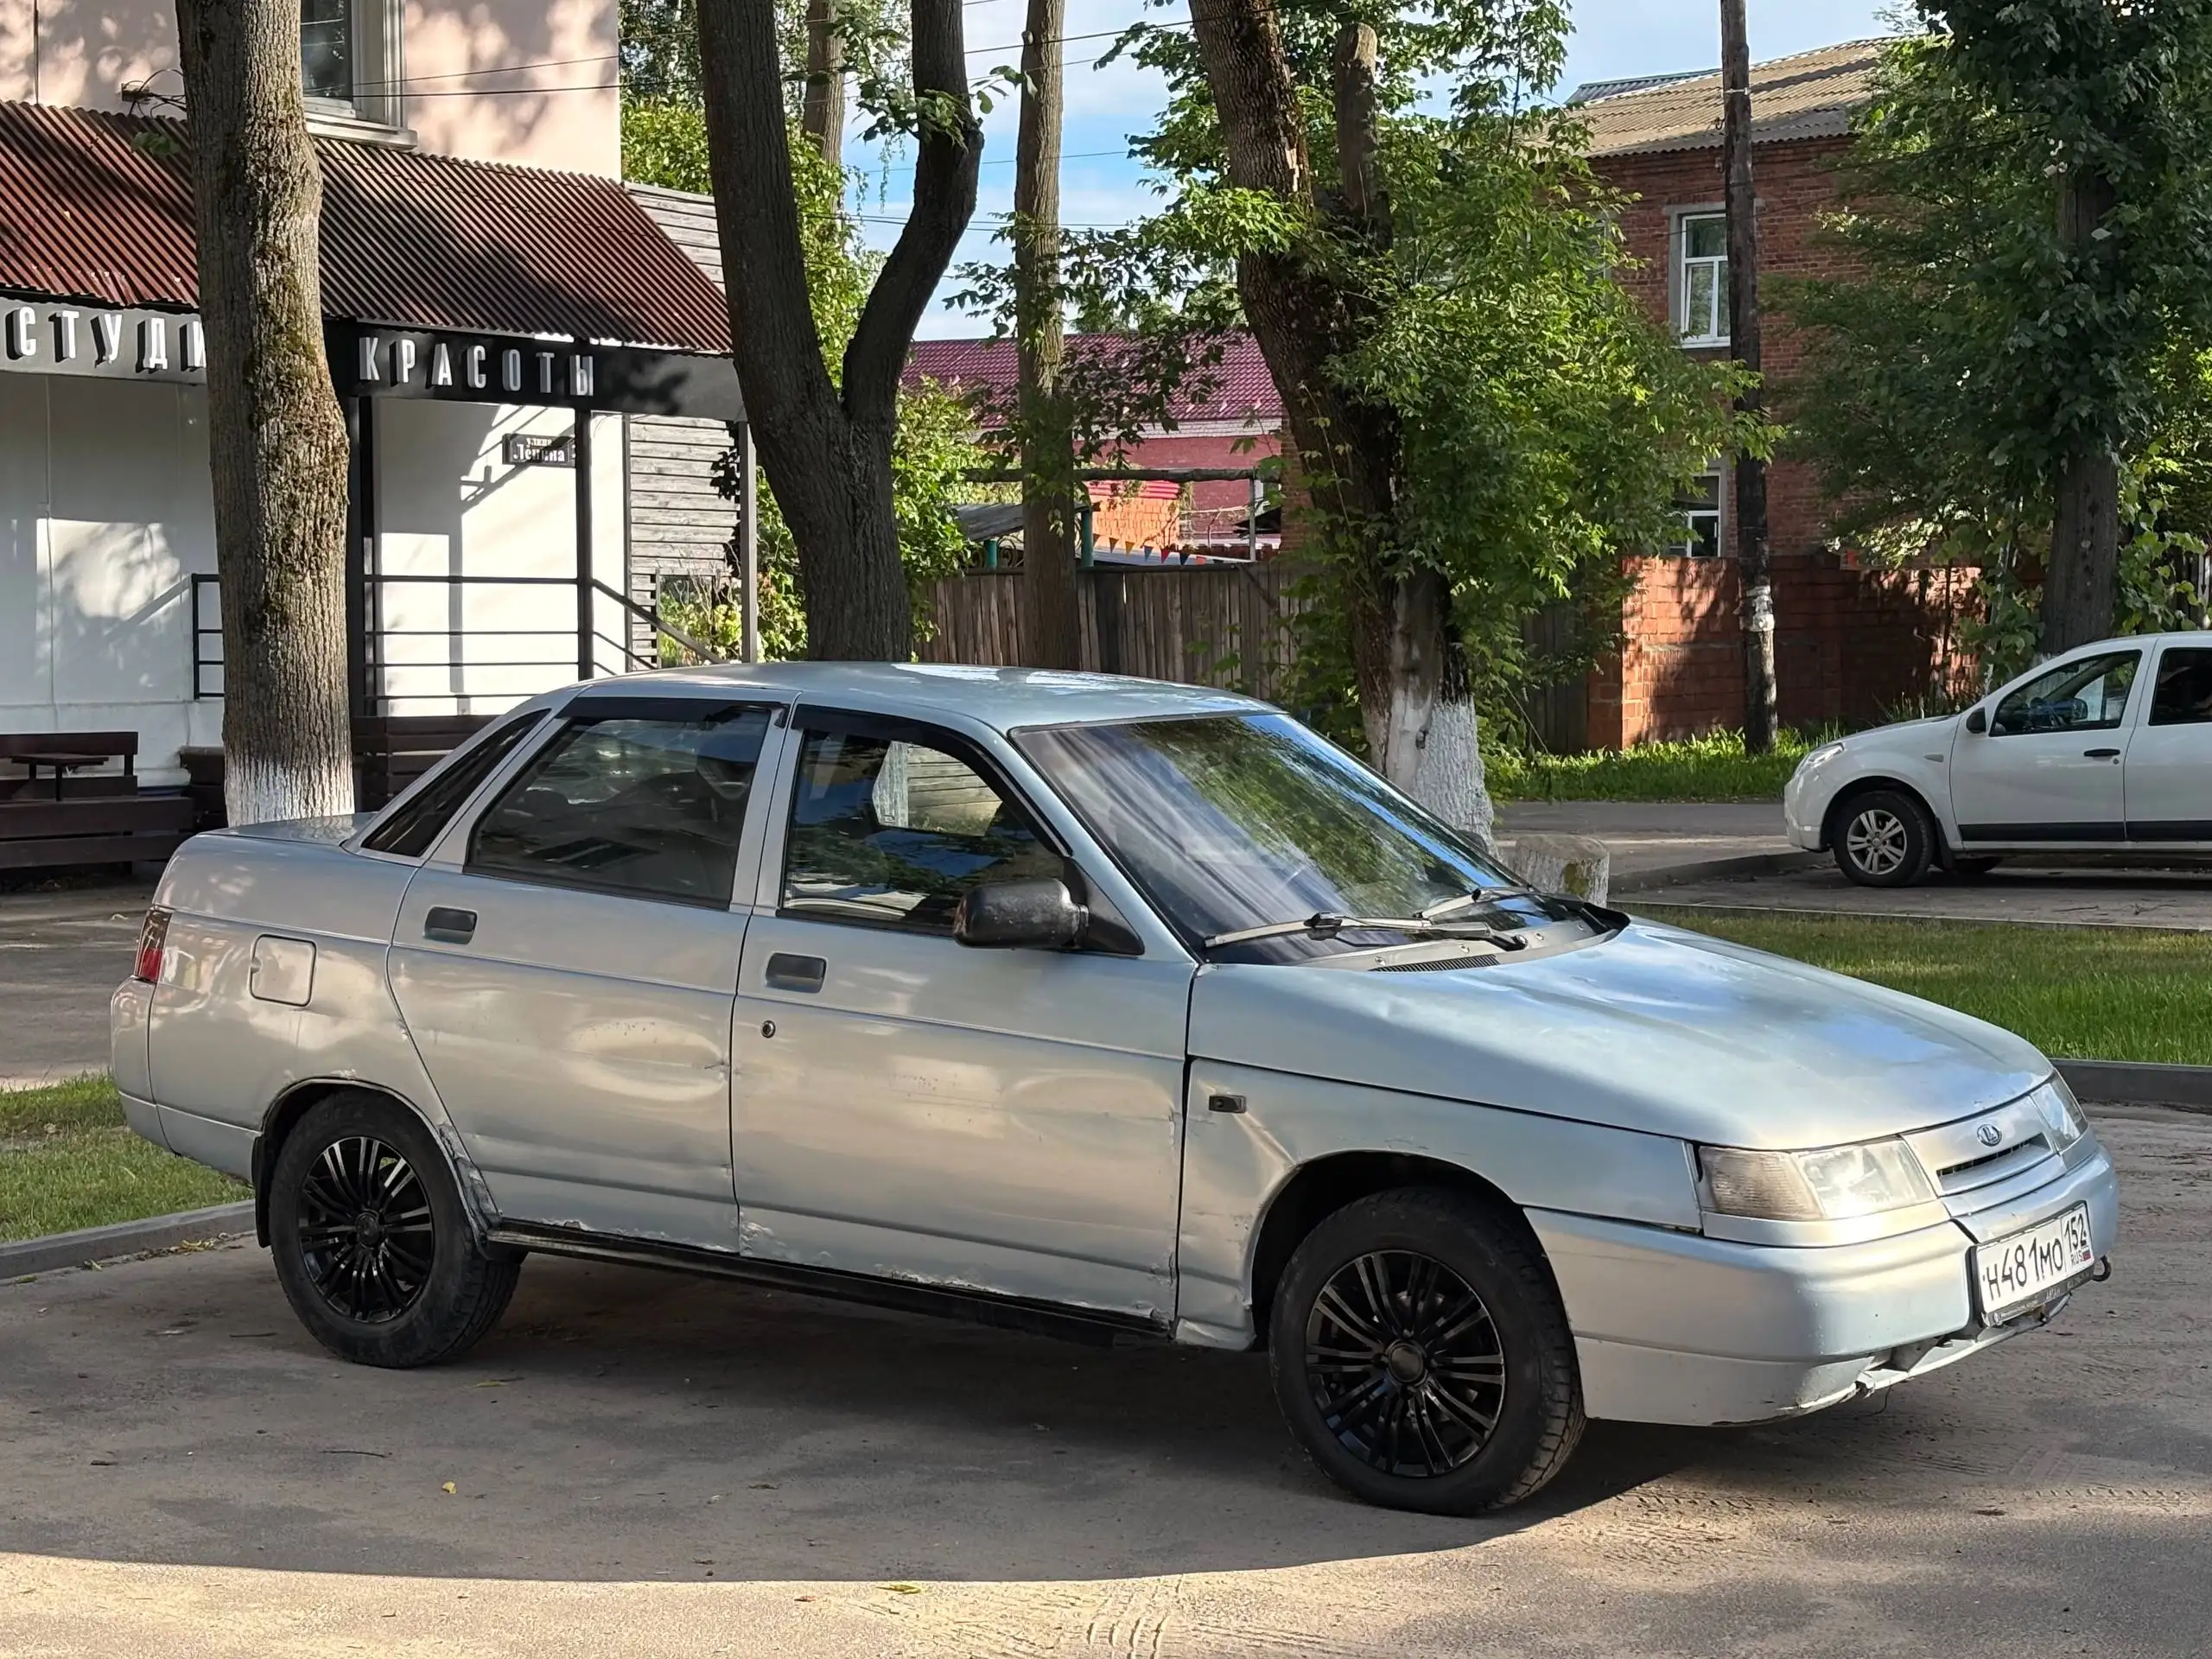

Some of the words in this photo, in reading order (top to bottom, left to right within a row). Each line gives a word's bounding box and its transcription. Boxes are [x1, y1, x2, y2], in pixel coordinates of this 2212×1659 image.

[359, 336, 594, 397] КРАСОТЫ
[1986, 1236, 2063, 1301] Н481МО
[2063, 1212, 2087, 1253] 152
